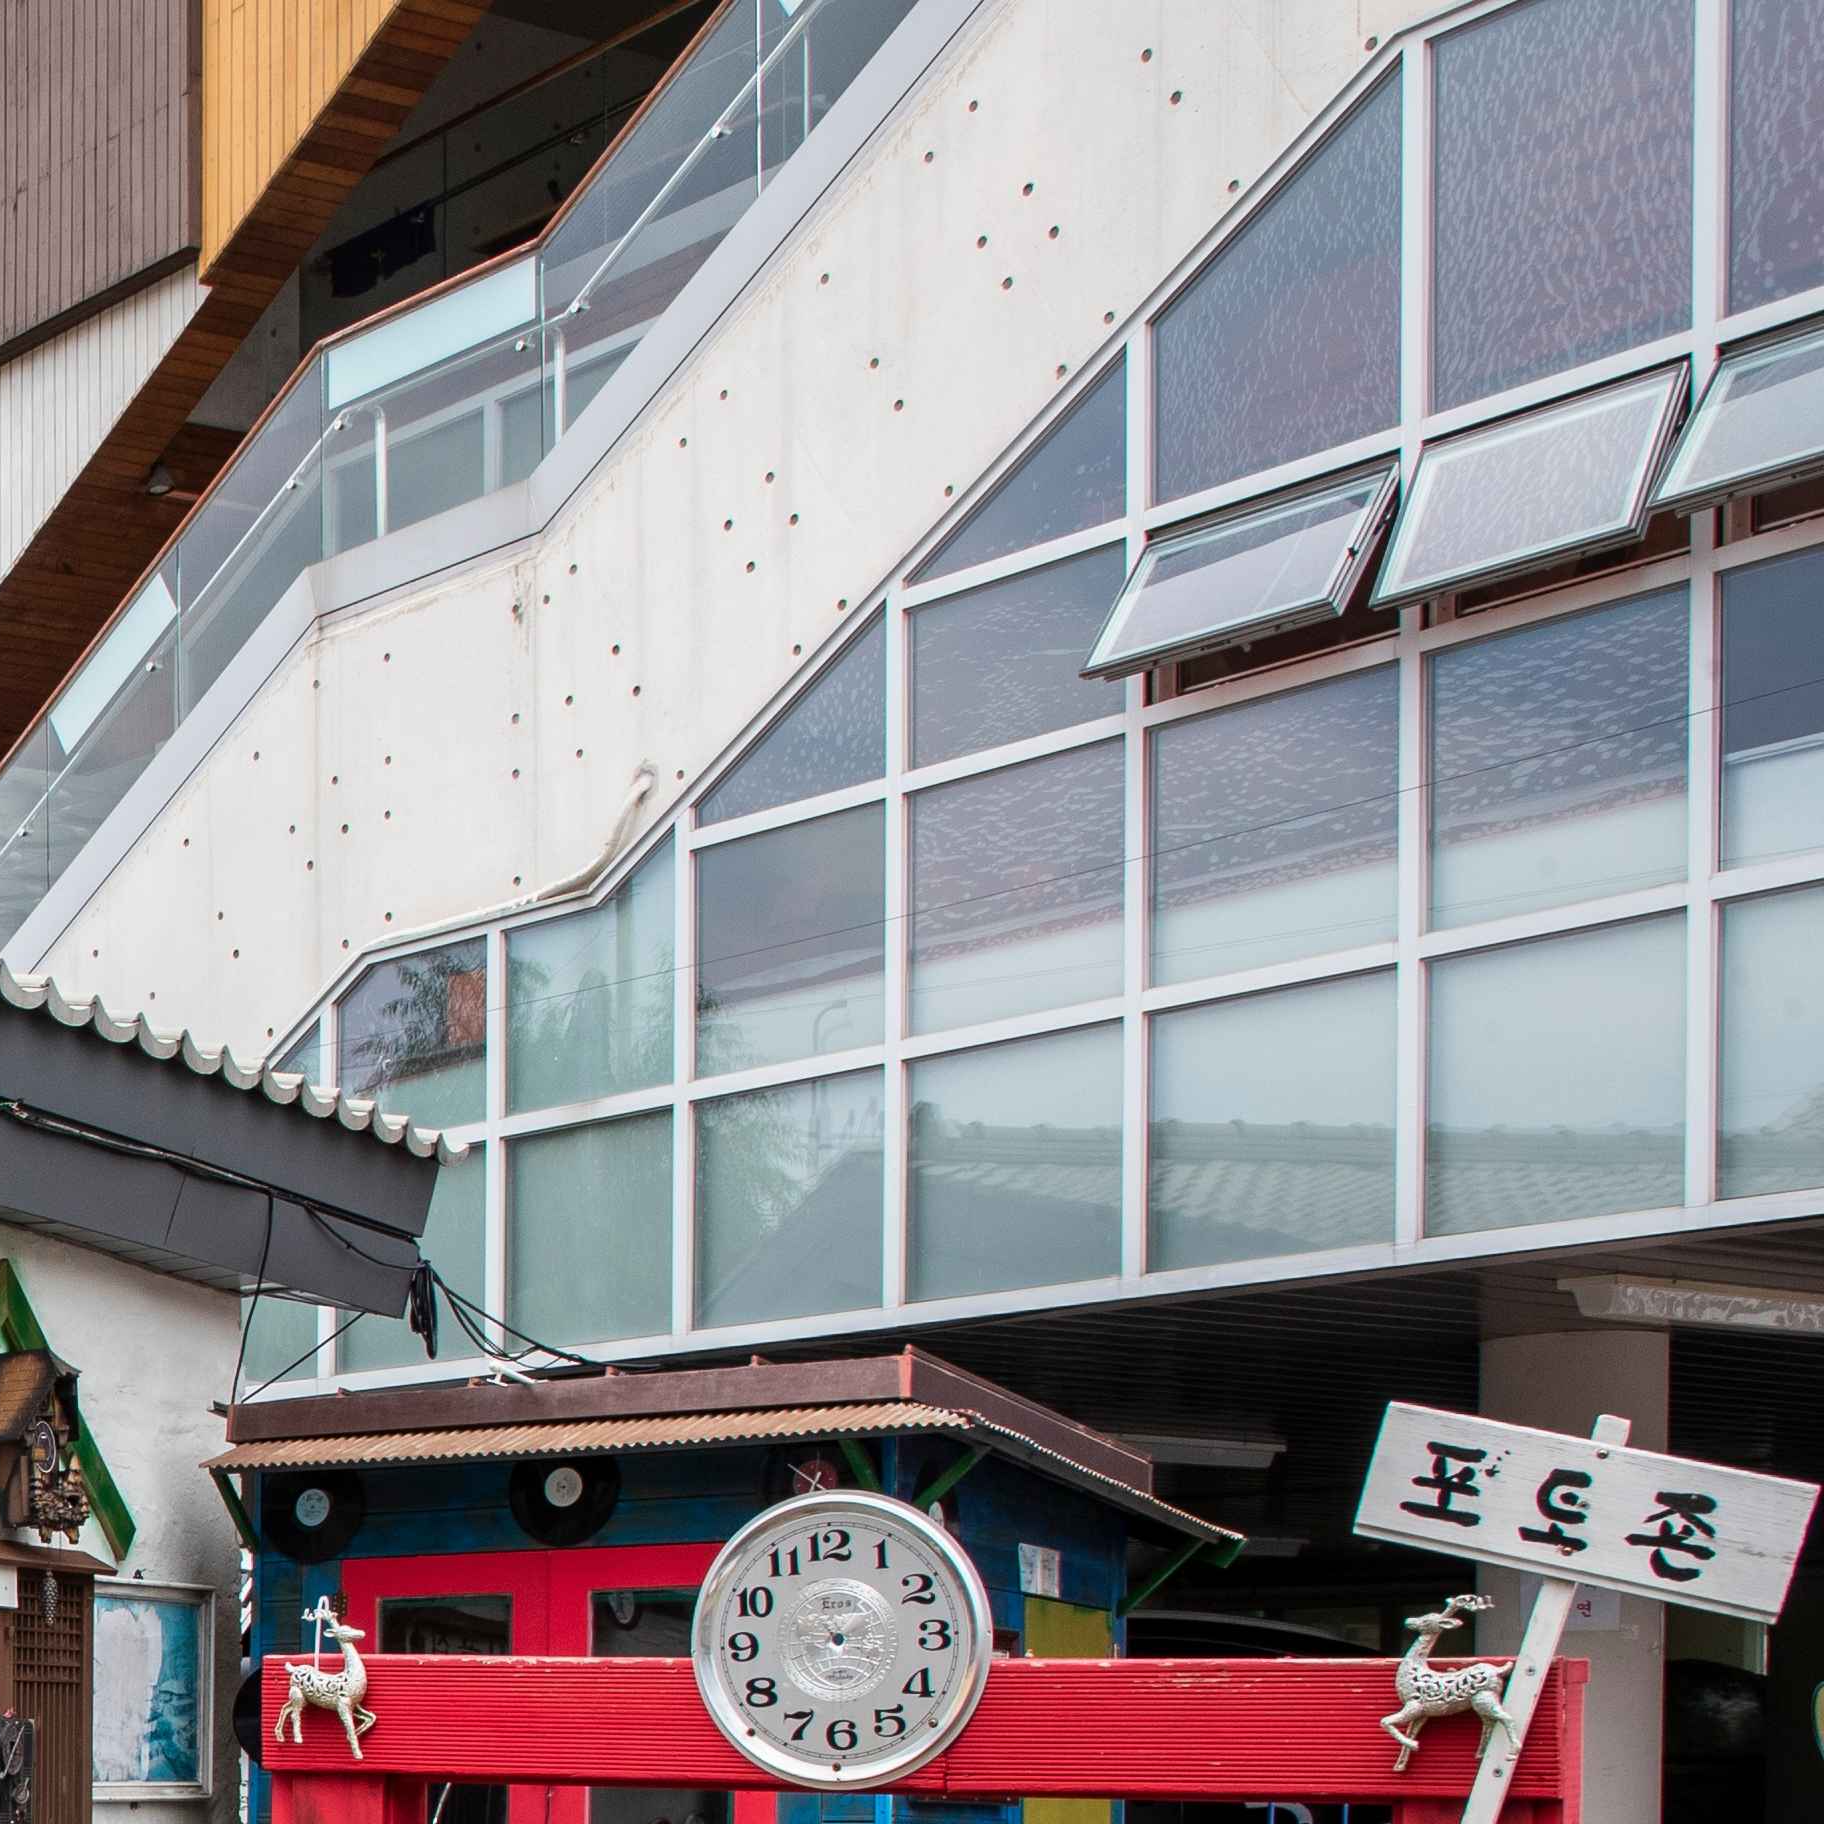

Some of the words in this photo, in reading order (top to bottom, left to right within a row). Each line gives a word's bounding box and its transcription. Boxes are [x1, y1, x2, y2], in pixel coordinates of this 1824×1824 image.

[1399, 1441, 1718, 1583] 포토존
[768, 1544, 801, 1577] 11
[808, 1529, 852, 1563] 12
[873, 1539, 889, 1569] 1
[736, 1586, 774, 1617] 10
[901, 1573, 936, 1605] 2
[728, 1632, 759, 1662] 9
[918, 1619, 952, 1651] 3
[745, 1677, 779, 1708] 8
[902, 1667, 936, 1698] 4
[783, 1708, 814, 1741] 7
[826, 1719, 858, 1751] 6
[873, 1703, 907, 1737] 5
